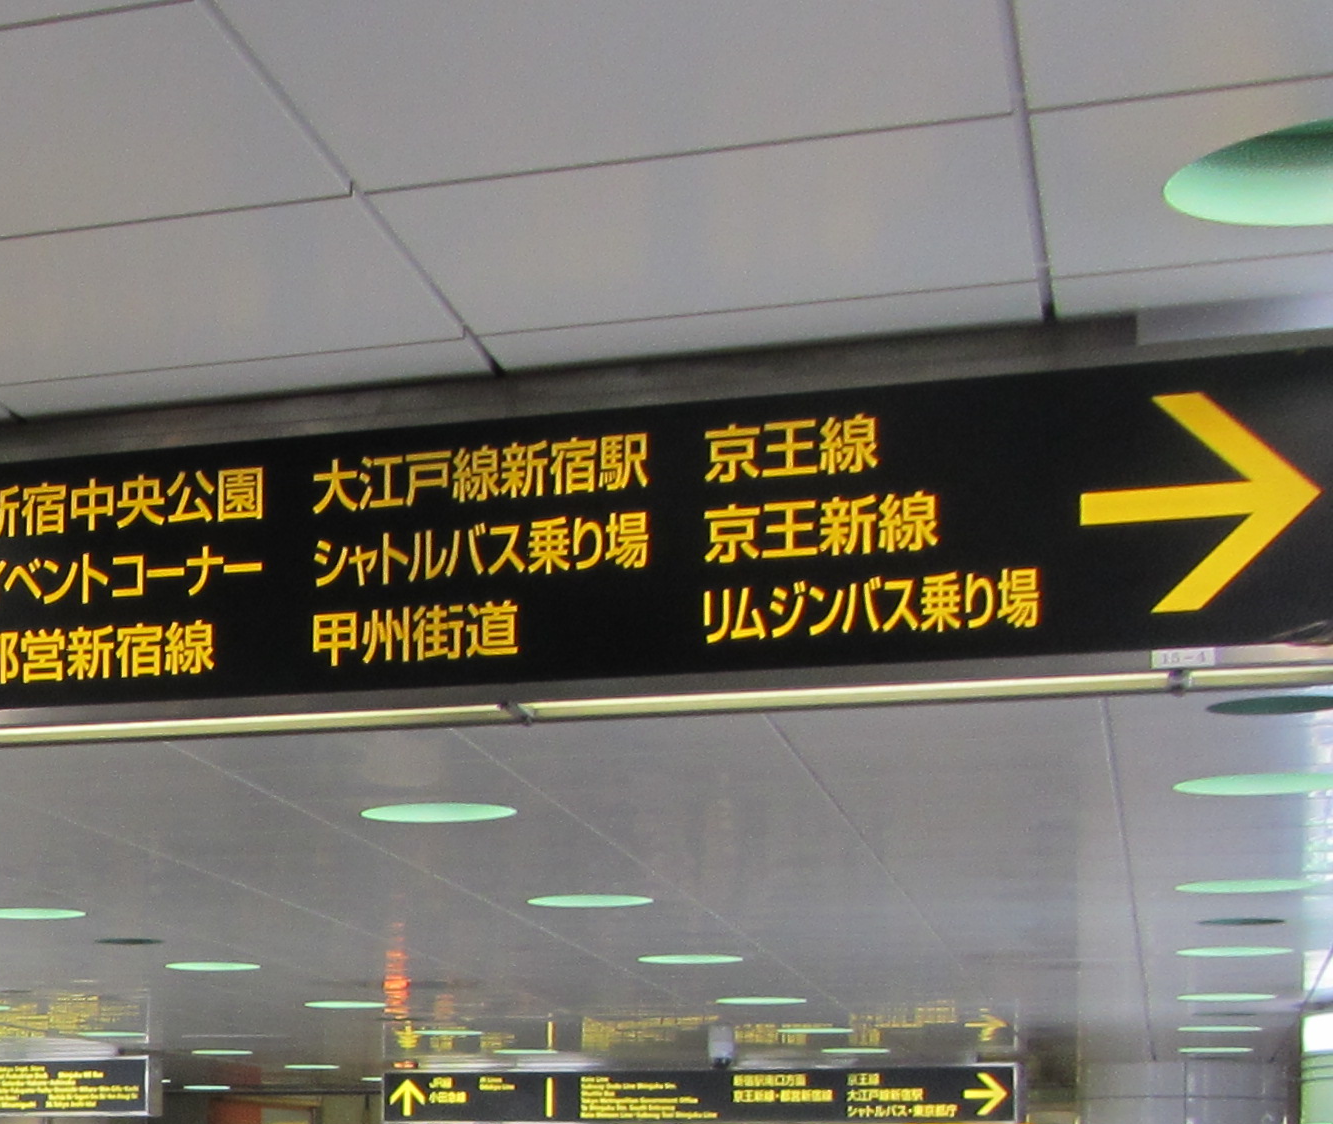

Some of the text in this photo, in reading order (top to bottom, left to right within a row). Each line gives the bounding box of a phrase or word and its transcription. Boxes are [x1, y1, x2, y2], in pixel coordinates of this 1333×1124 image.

[313, 432, 651, 513] 大江戸線新宿駅
[705, 413, 880, 483] 京王線
[315, 511, 651, 587] シャトルバス乗り場
[705, 490, 941, 564] 京王新線
[313, 600, 519, 666] 甲州街道
[704, 567, 1043, 643] リムジンバス乗り場
